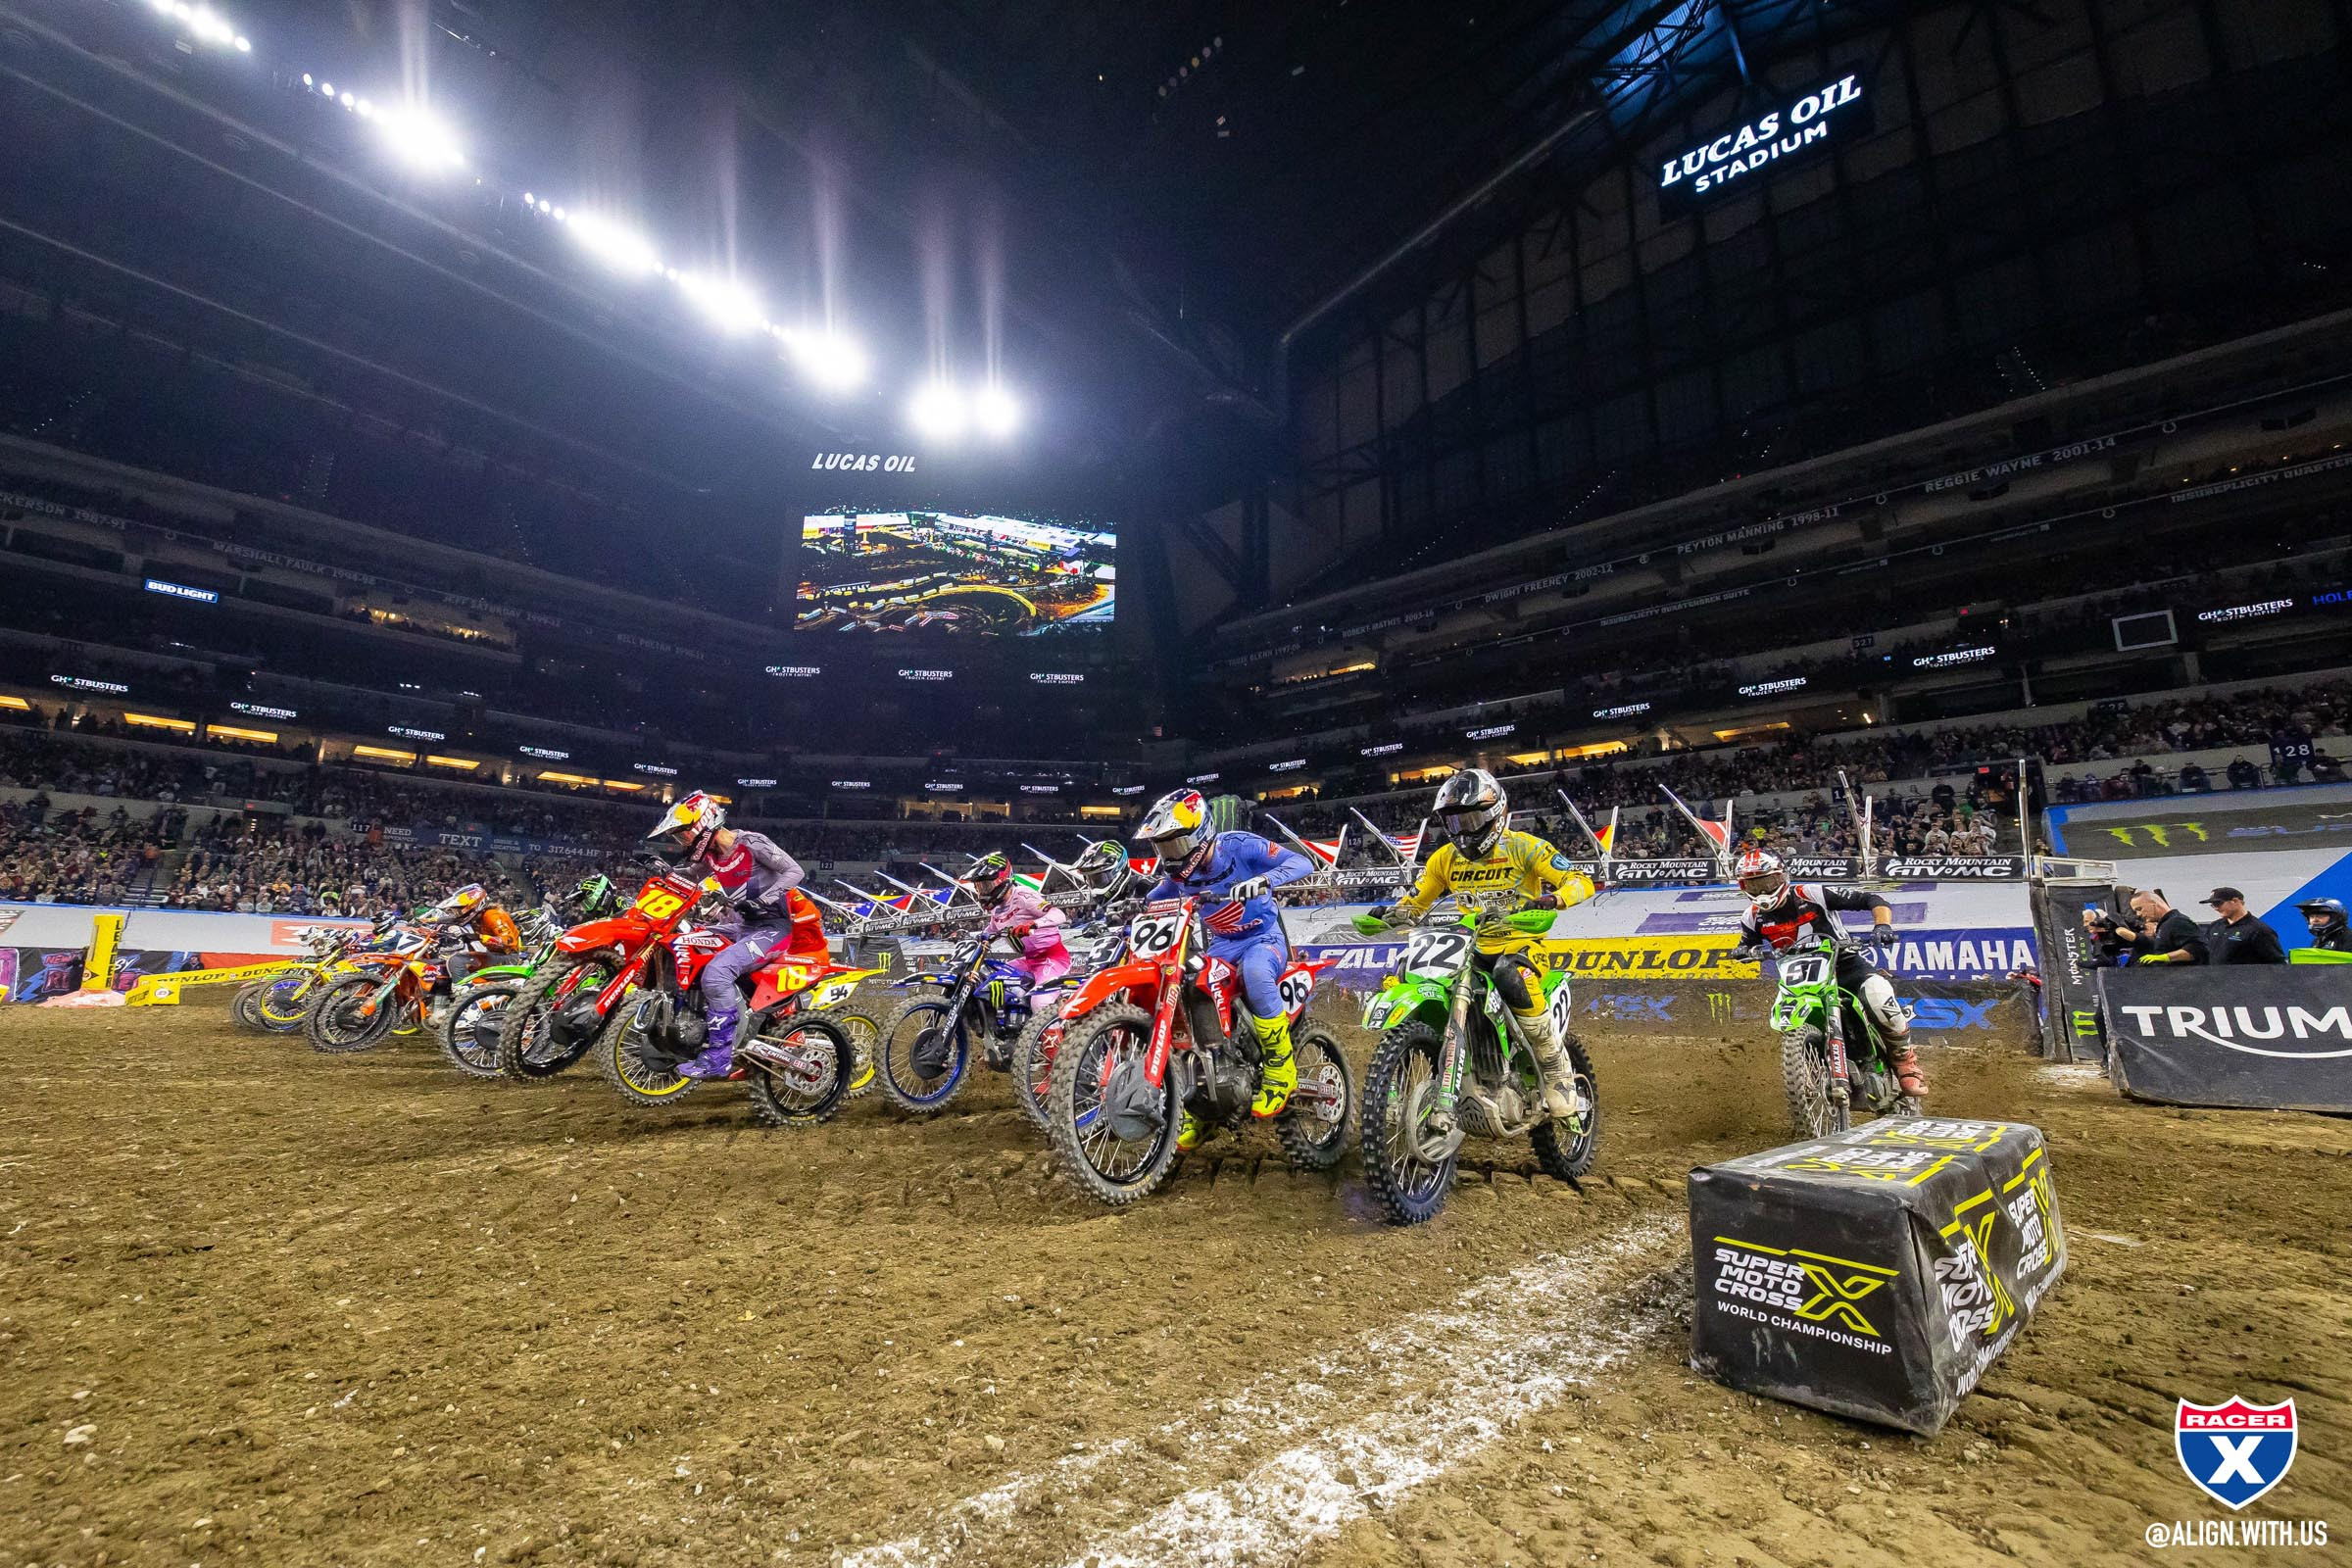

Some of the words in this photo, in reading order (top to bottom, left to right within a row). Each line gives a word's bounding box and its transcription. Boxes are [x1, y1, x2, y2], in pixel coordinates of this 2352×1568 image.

[1661, 112, 1779, 186] LUCAS
[1790, 74, 1861, 124] OIL
[1695, 121, 1827, 193] STADIUM
[811, 453, 880, 472] LUCAS
[883, 455, 916, 473] OIL
[1925, 471, 1982, 494] REGGIE
[1985, 454, 2043, 477] WAYNE
[2052, 437, 2118, 462] 2001-14
[1677, 535, 1724, 556] PEYTON
[1727, 521, 1786, 542] MANNING
[1790, 506, 1840, 527] 1998-11
[213, 540, 281, 565] MARSHALL
[285, 555, 325, 575] FAULK
[148, 580, 176, 594] BUD
[177, 584, 216, 601] LIGHT
[1485, 588, 1521, 605] DWIGHT
[1524, 573, 1569, 594] FREENEY
[1574, 564, 1615, 582] 2002-12
[2198, 599, 2293, 620] GHSTBUSTERS
[1343, 625, 1370, 639] ROBERT
[1371, 617, 1401, 631] MATHIS
[1913, 646, 1995, 666] GHSTBUSTERS
[765, 665, 820, 675] GHSTBUSTERS
[899, 668, 953, 677] GHSTBUSTERS
[1030, 672, 1085, 681] GHSTBUSTERS
[51, 673, 128, 693] GHSTBUSTERS
[1739, 677, 1807, 695] GHSTBUSTERS
[230, 702, 297, 717] GHSTBUSTERS
[1592, 702, 1650, 717] GHSTBUSTERS
[388, 725, 445, 740] GHSTBUSTERS
[1466, 724, 1515, 738] GHSTBUSTERS
[519, 745, 569, 759] GHSTBUSTERS
[1361, 743, 1403, 756] GHSTBUSTERS
[2274, 744, 2311, 758] 128
[634, 763, 677, 775] GHSTBUSTERS
[1269, 759, 1306, 770] GHSTBUSTERS
[1187, 773, 1219, 784] GHSTBUSTERS
[1112, 785, 1145, 794] GHSTBUSTERS
[352, 823, 370, 832] 117
[383, 826, 412, 836] NEED
[439, 833, 483, 849] TEXT
[1663, 860, 1708, 869] MOUNTAIN
[1904, 858, 1941, 866] ROCKY
[1943, 858, 2012, 866] MOUNTAIN
[1450, 866, 1514, 882] CIRCUIT
[636, 889, 684, 919] 18
[1475, 888, 1516, 900] MADD
[1429, 914, 1460, 924] psychic
[682, 937, 718, 948] HONDA
[1133, 921, 1174, 953] 96
[105, 919, 122, 989] LEADER
[1409, 933, 1465, 971] 22
[1547, 948, 1735, 971] DUNLOP
[1882, 940, 2036, 971] YAMAHA
[2064, 927, 2084, 985] MONSTER
[2079, 936, 2090, 976] EERGY
[604, 968, 636, 1008] DUNLOP
[776, 965, 808, 993] 18
[830, 988, 850, 1002] 94
[1280, 978, 1309, 1010] 96
[1553, 989, 1571, 1034] 22
[2122, 1005, 2352, 1040] TRIUM
[1151, 1020, 1168, 1076] DUNLOP
[1833, 1043, 1844, 1075] MAXXIS
[1454, 1049, 1466, 1093] MAXXIS
[2009, 1187, 2035, 1228] SUPER
[2022, 1212, 2041, 1253] MOTO
[1714, 1249, 1805, 1280] SUPER
[2017, 1238, 2047, 1280] CROSS
[1720, 1264, 1801, 1297] MOTO
[1714, 1278, 1804, 1311] CROSS
[1717, 1300, 1768, 1322] WORLD
[1770, 1316, 1892, 1355] CHAMPIONSHIP
